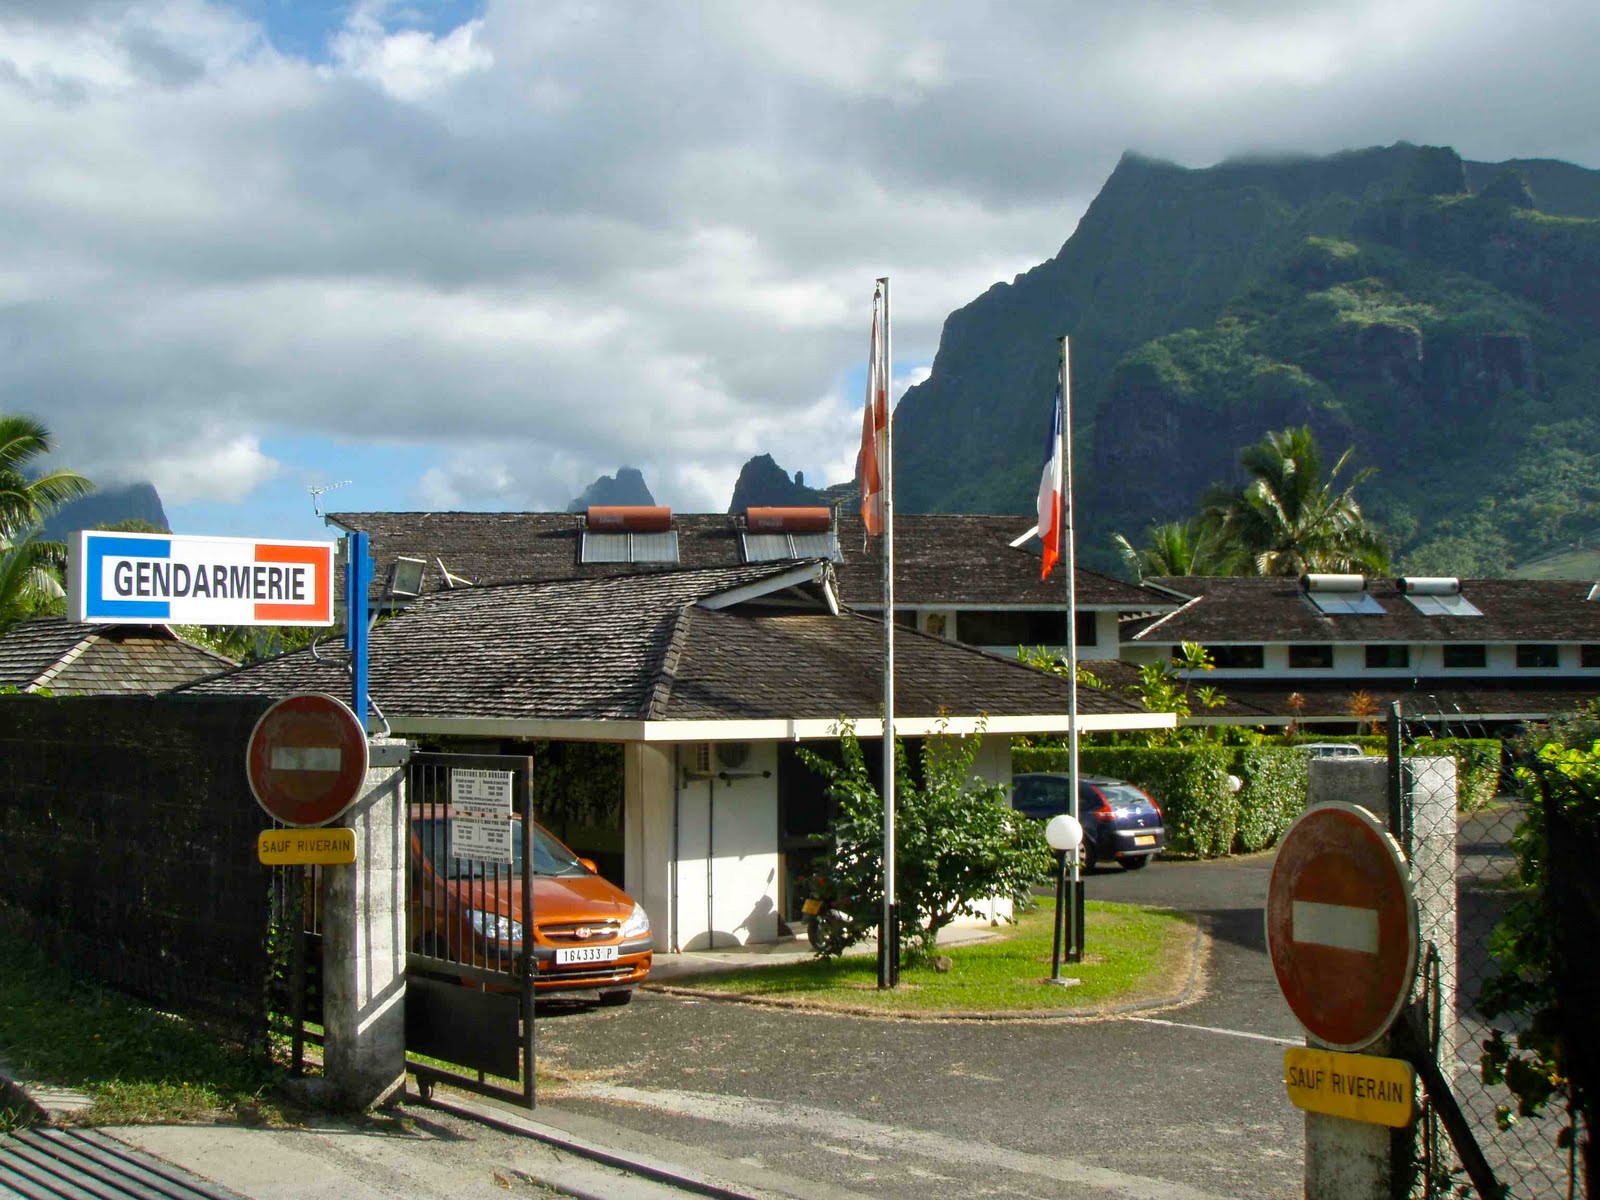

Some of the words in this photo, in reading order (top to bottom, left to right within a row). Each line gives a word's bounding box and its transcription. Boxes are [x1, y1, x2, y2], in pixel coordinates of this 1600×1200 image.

[114, 560, 305, 600] GENDARMERIE
[262, 840, 291, 853] SAUF
[297, 839, 350, 853] RIVERAIN
[564, 948, 601, 962] 164333
[606, 947, 612, 959] P
[1289, 1066, 1324, 1090] SAUF
[1331, 1073, 1403, 1104] RIVERAIN
